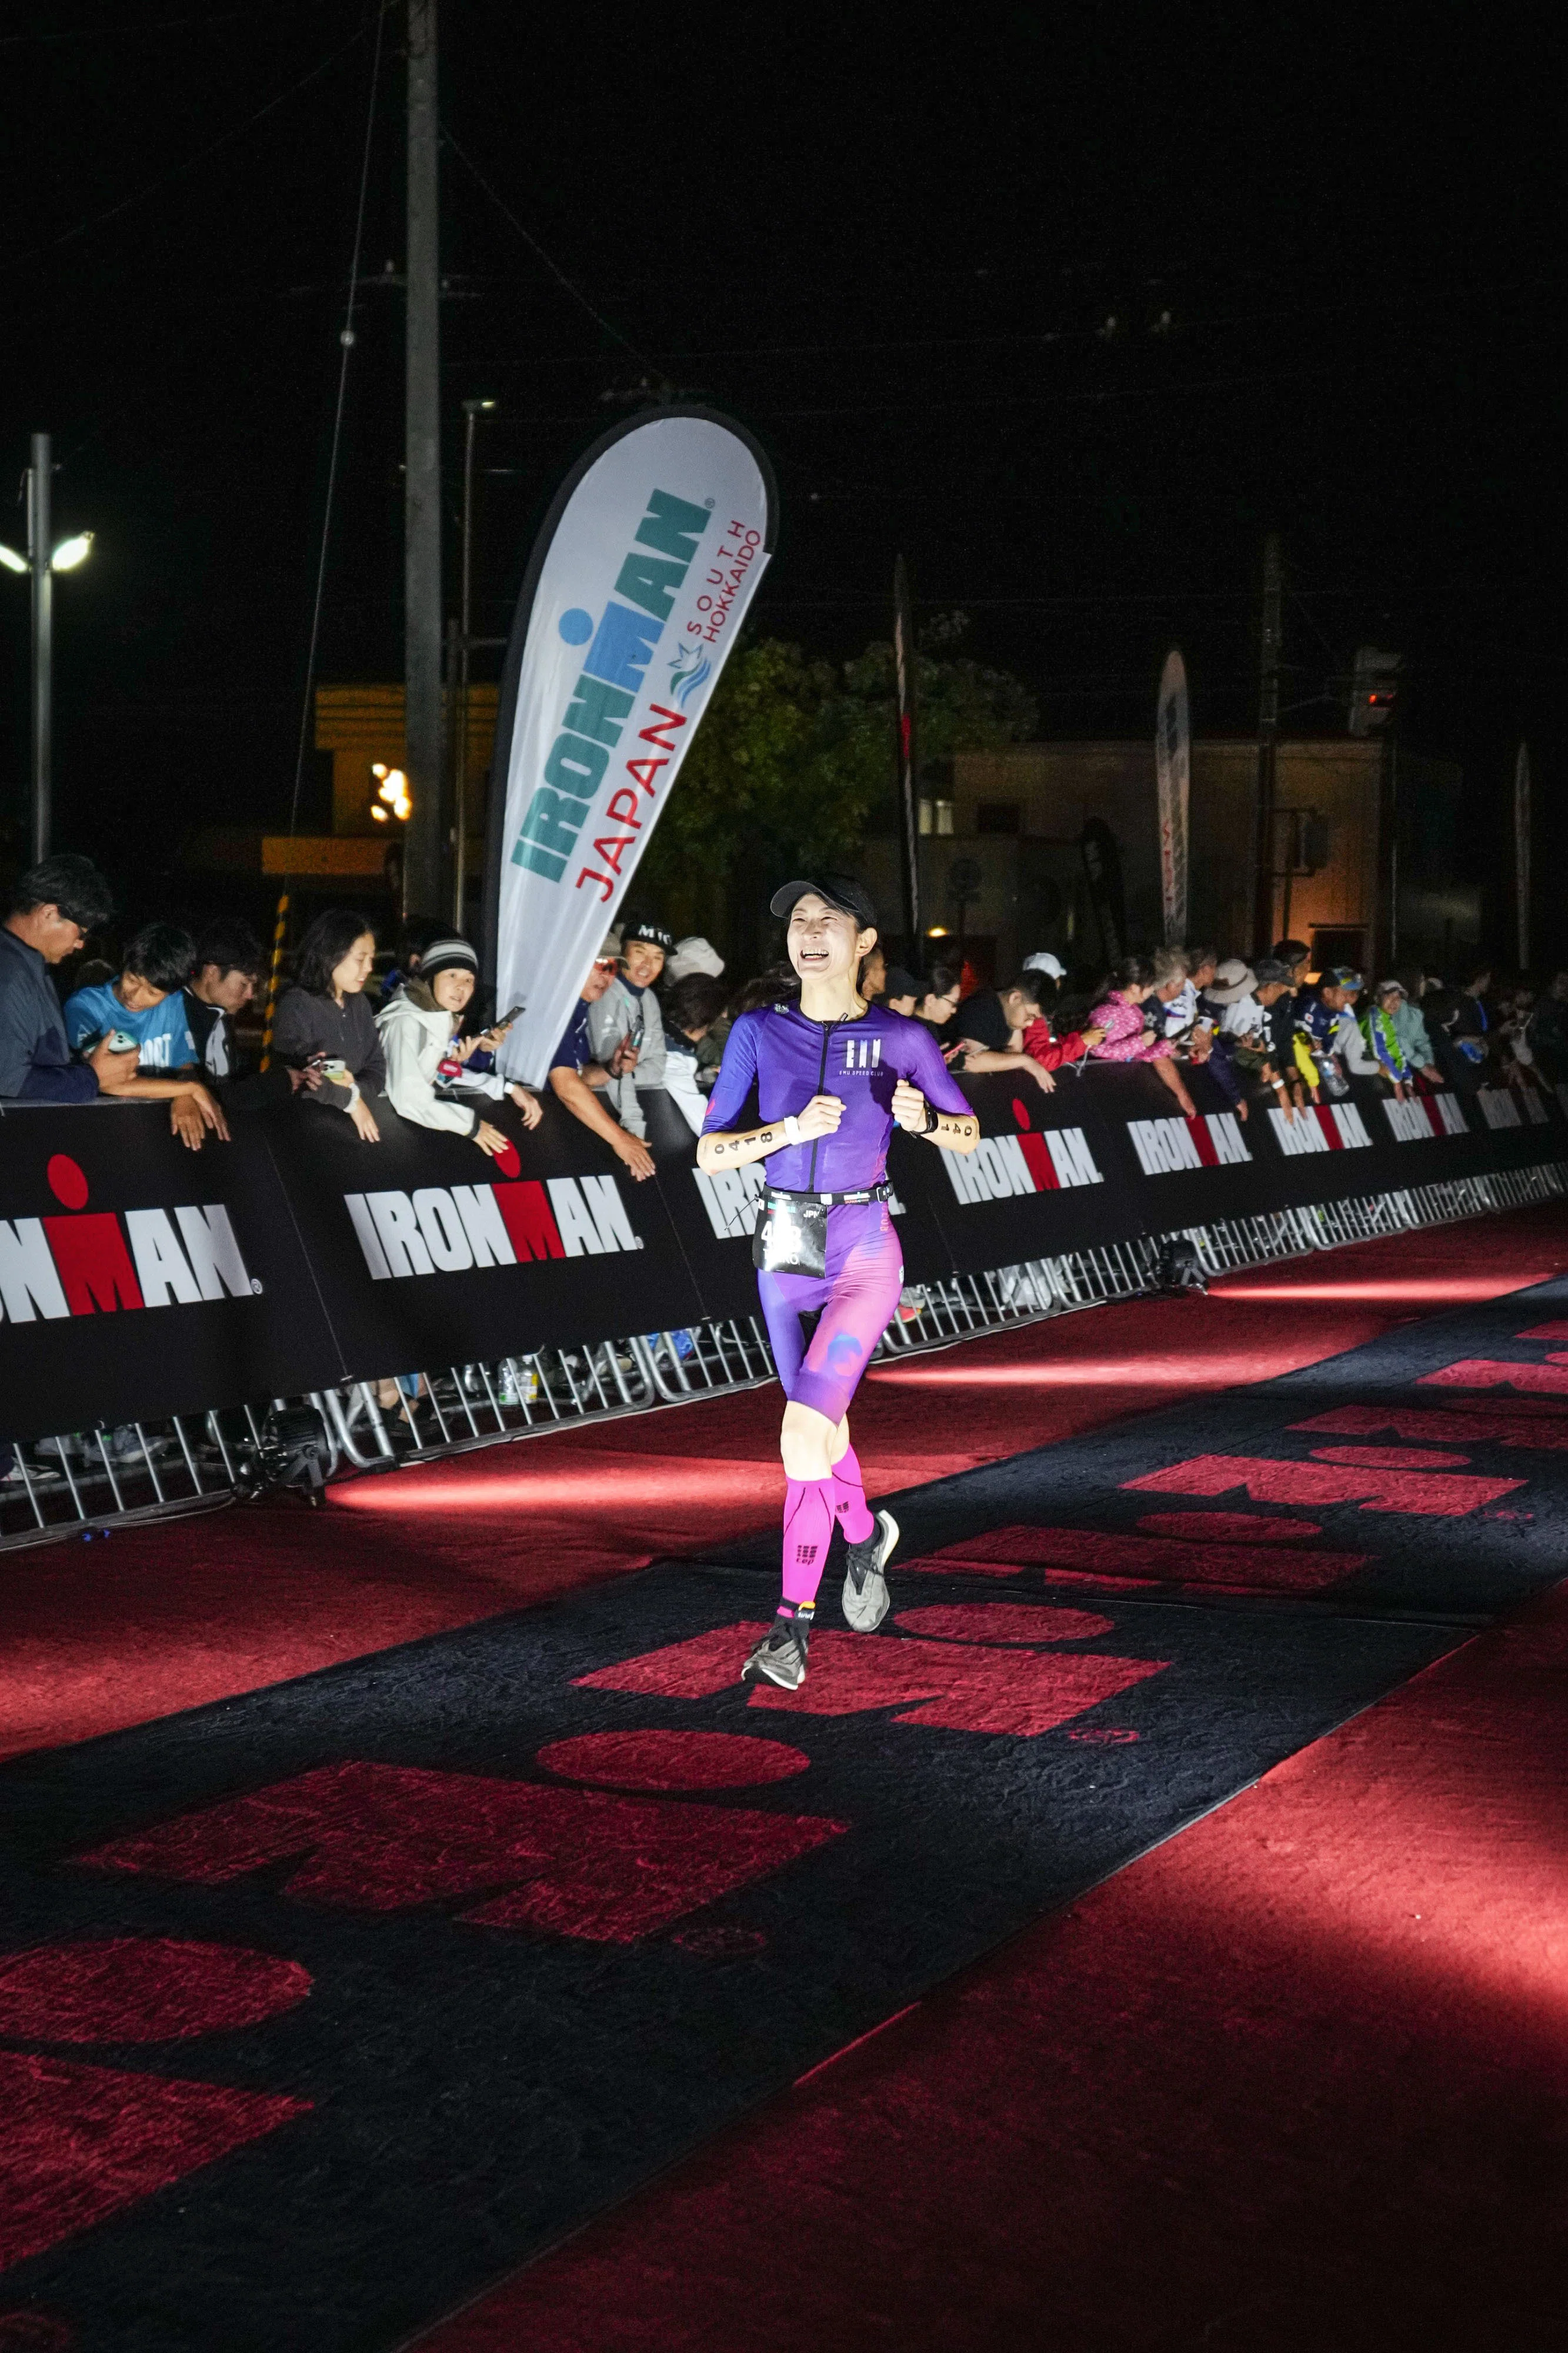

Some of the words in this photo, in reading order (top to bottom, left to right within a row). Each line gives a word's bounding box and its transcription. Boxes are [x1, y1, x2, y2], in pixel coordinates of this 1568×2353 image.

[687, 520, 745, 635] SOUTH
[703, 530, 760, 643] HOKKAIDO
[511, 488, 712, 883] IRONMAN
[575, 704, 688, 902] JAPAN
[715, 1131, 773, 1154] 0418
[939, 1128, 1102, 1205] IRONMAN
[1127, 1112, 1250, 1175] IRONMAN
[0, 1204, 254, 1324] NMAN
[344, 1175, 638, 1279] IRONMAN
